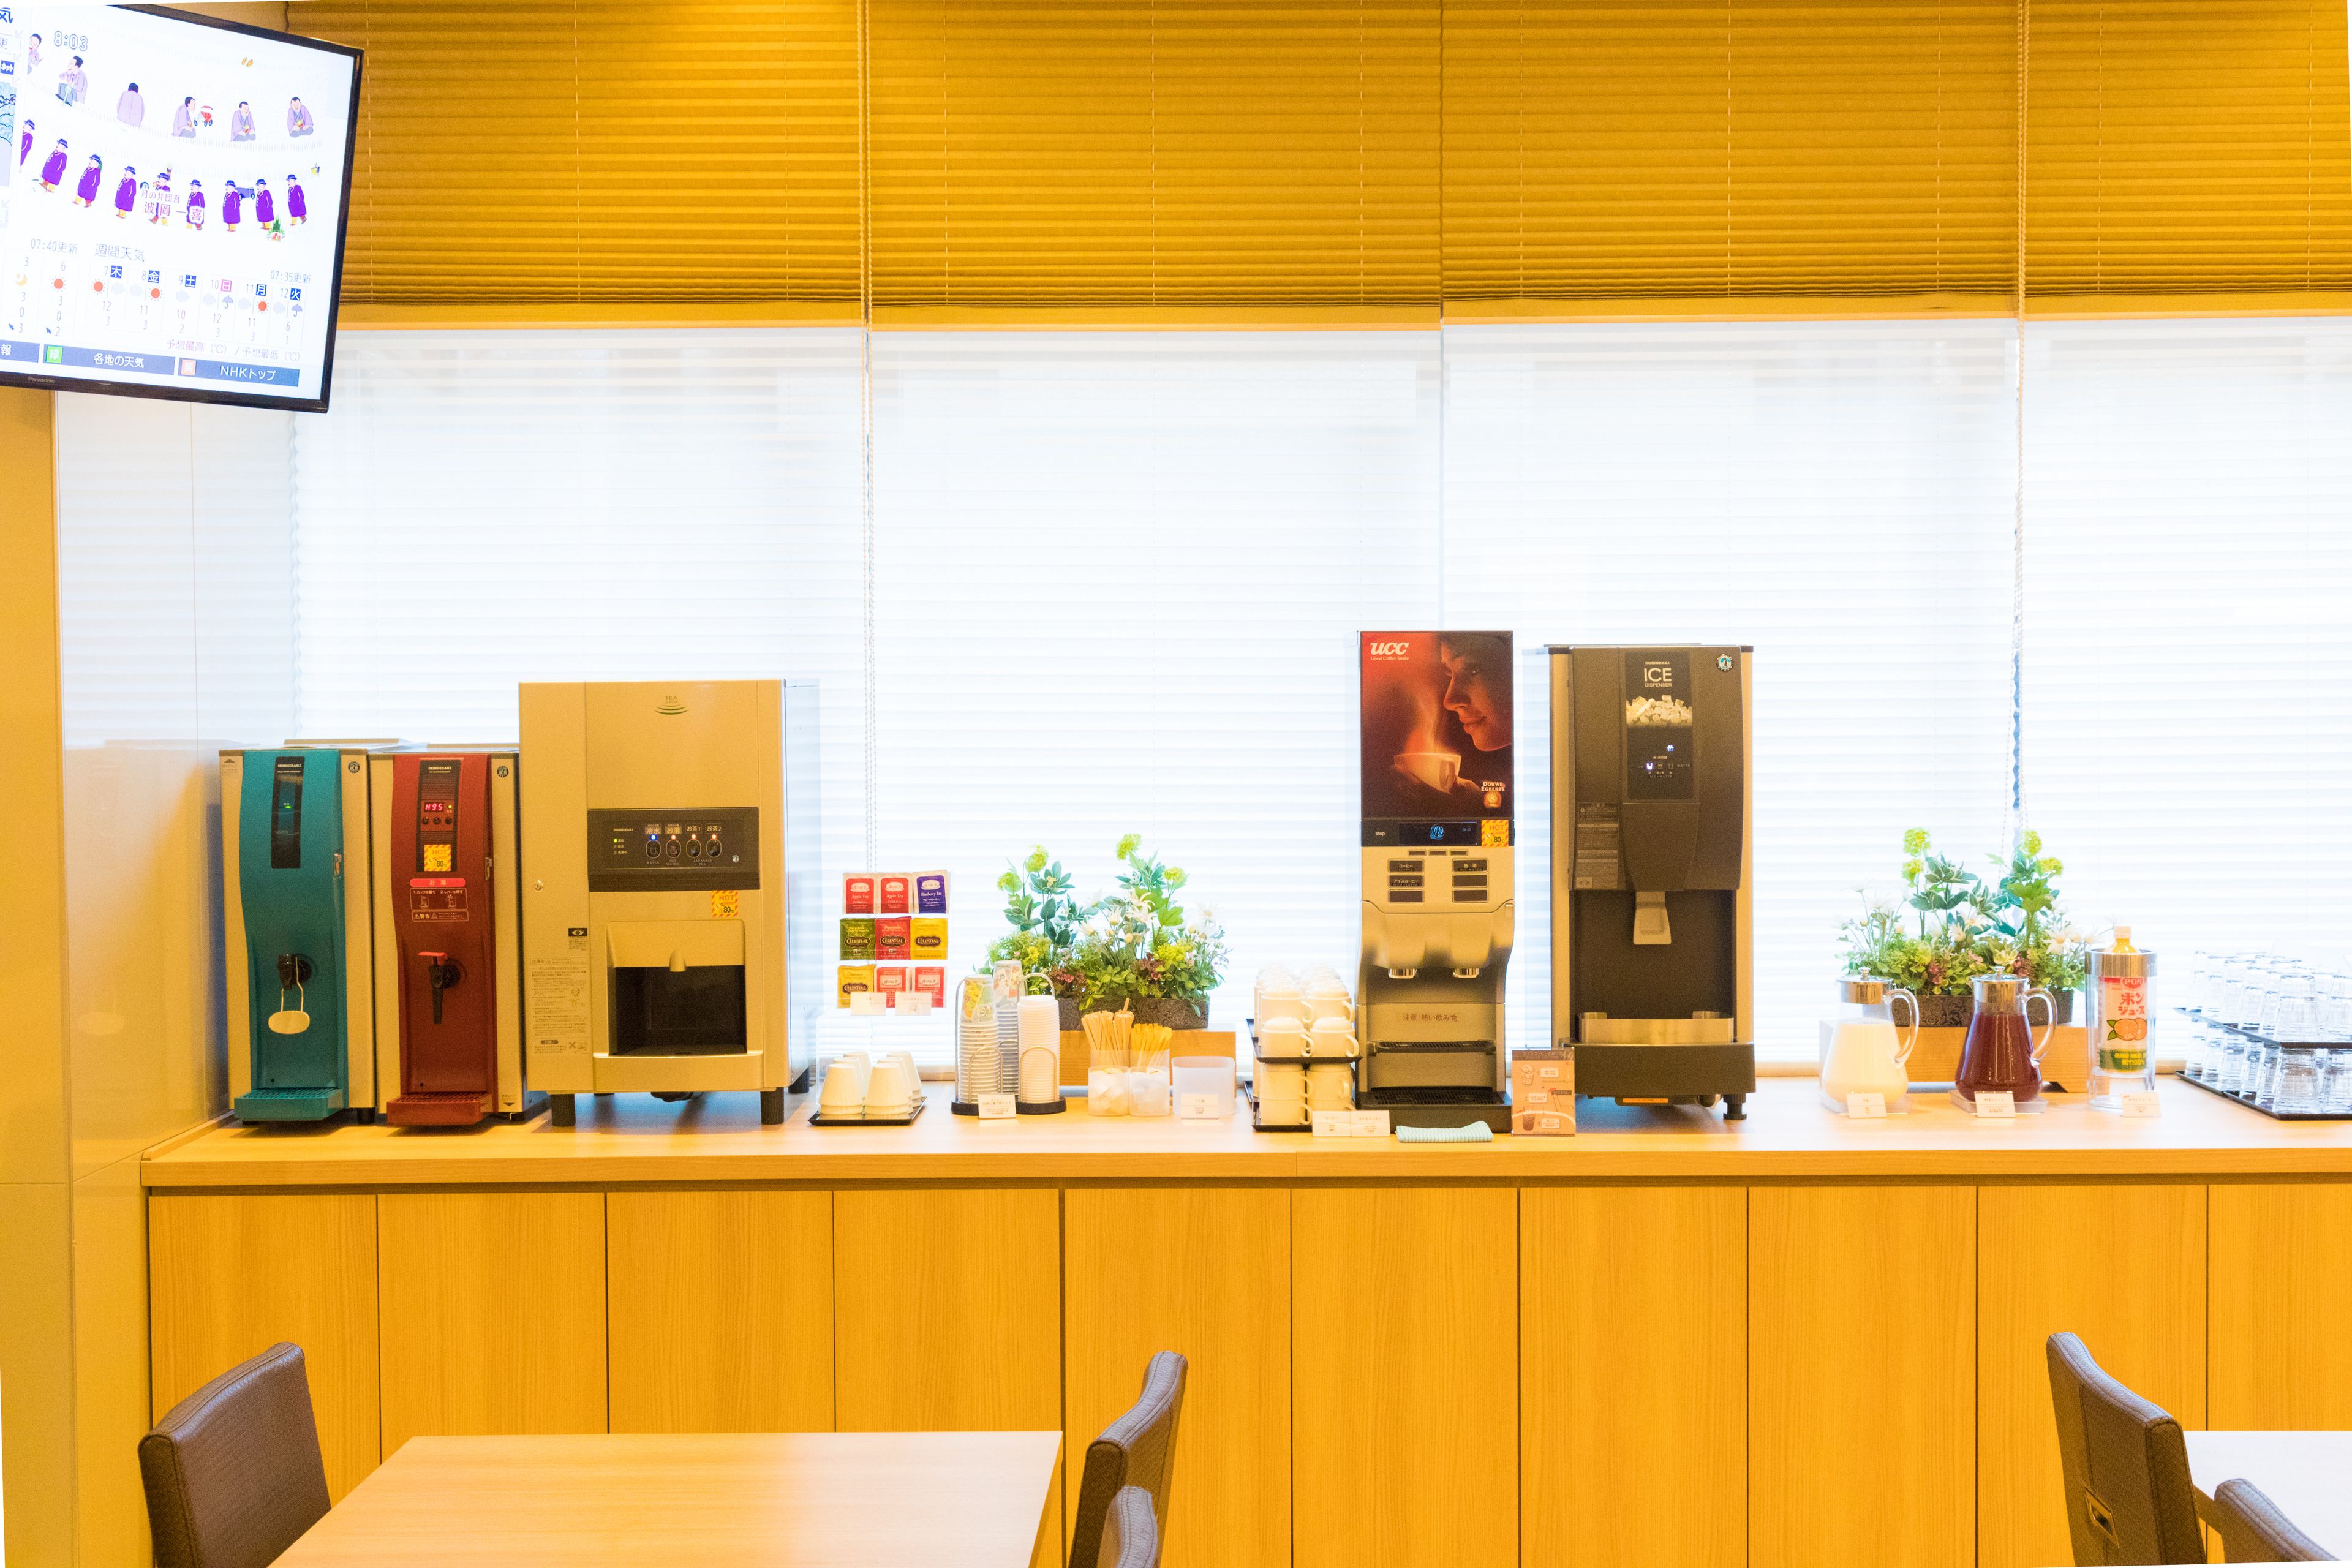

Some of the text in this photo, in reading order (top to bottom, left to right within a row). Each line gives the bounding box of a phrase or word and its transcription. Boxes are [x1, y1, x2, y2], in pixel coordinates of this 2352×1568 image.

[54, 31, 88, 52] 8:03
[144, 201, 203, 221] 波岡一喜
[95, 243, 146, 262] 週間天気
[61, 260, 66, 271] 6
[110, 266, 121, 277] 木
[141, 270, 160, 282] 8 金
[179, 275, 196, 287] 9 土
[211, 279, 231, 292] 10 日
[246, 283, 266, 295] 11 月
[281, 287, 301, 300] 12 火
[19, 307, 24, 317] 0
[103, 301, 111, 311] 12
[141, 305, 148, 315] 11
[57, 311, 62, 322] 0
[178, 309, 186, 319] 10
[213, 314, 222, 324] 12
[248, 317, 255, 328] 11
[286, 322, 290, 331] 6
[93, 353, 145, 369] 各地の天気
[220, 366, 277, 381] NHKトップ
[1644, 667, 1672, 682] ICE
[2120, 992, 2144, 1006] ポン
[2118, 1006, 2145, 1016] ジュース
